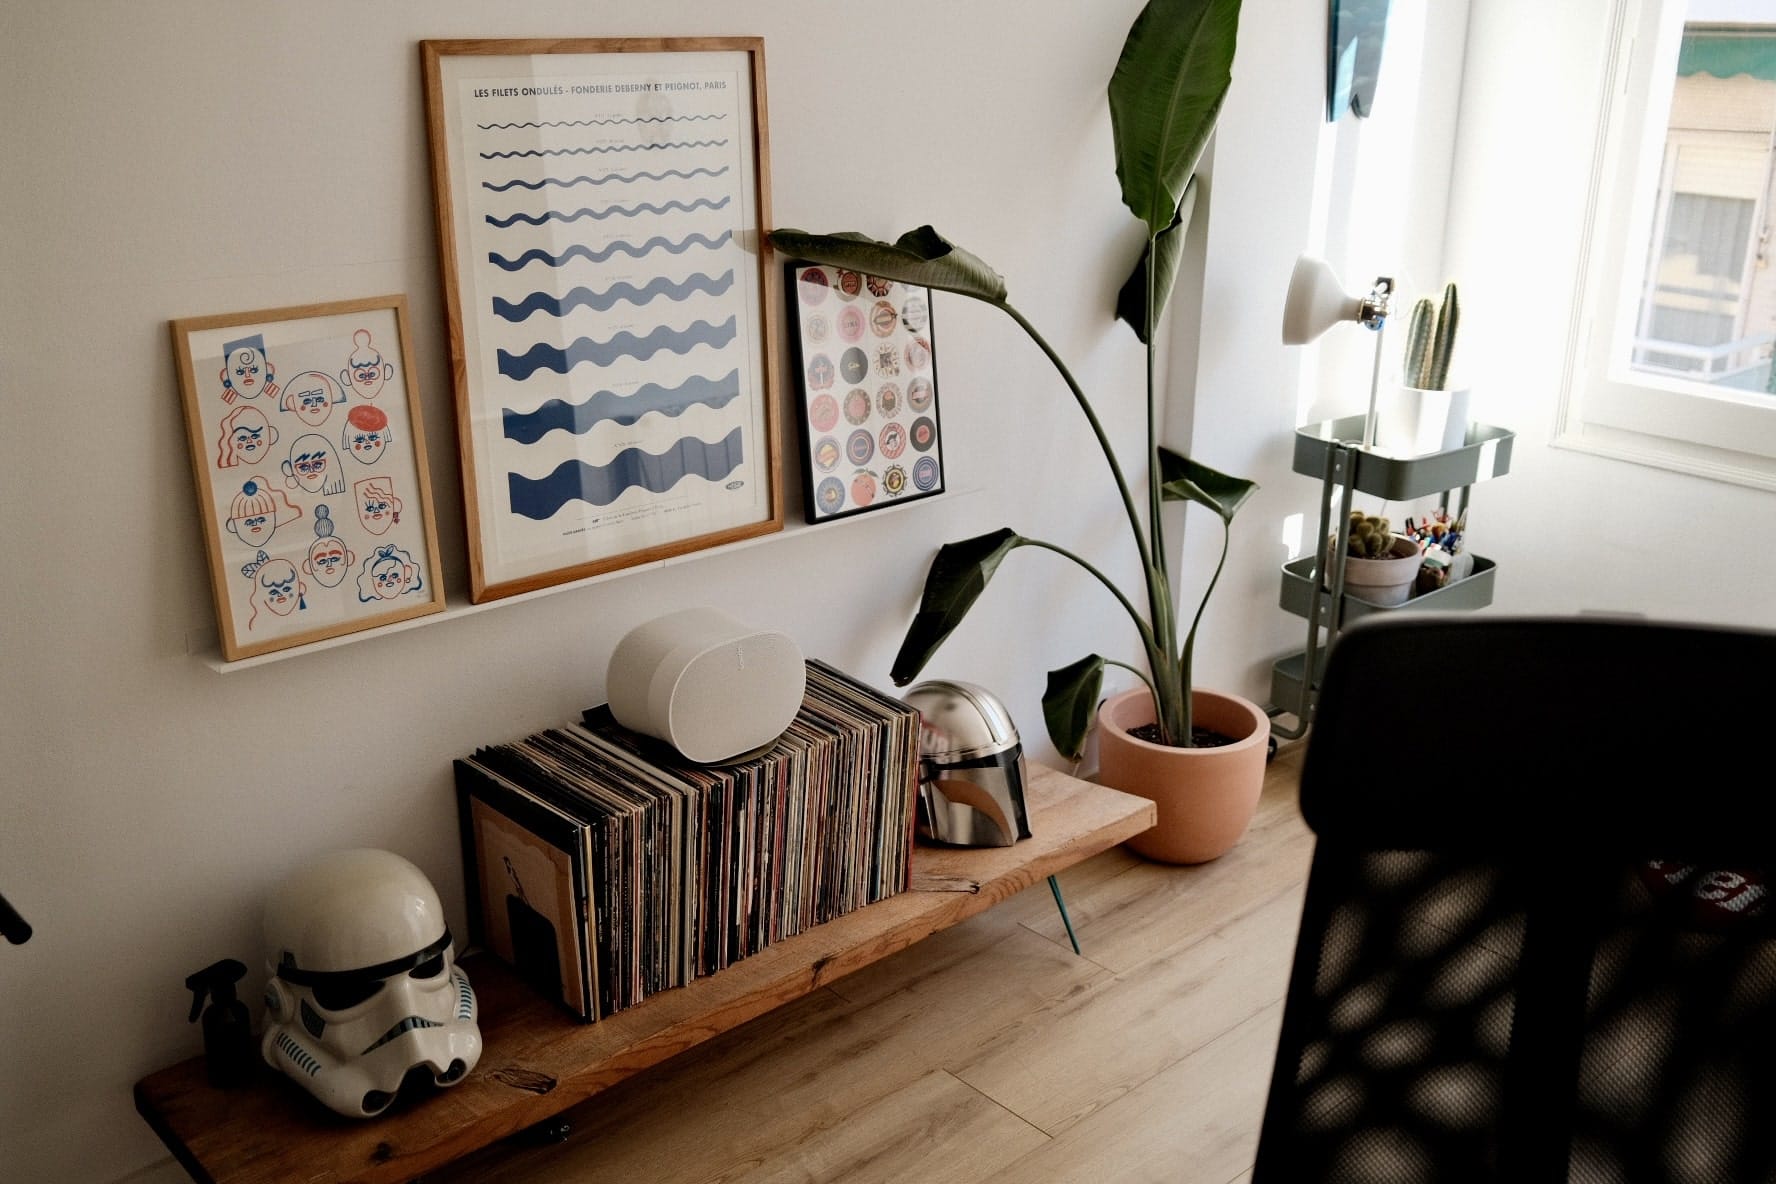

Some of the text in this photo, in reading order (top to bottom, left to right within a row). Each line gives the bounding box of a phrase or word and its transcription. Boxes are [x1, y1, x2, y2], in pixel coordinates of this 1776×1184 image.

[474, 89, 489, 98] LES
[492, 88, 519, 97] FILETS
[521, 85, 563, 96] ONDULÉS
[571, 84, 613, 94] FONDERIE
[615, 83, 651, 93] DEBERNY
[654, 83, 663, 92] ET
[704, 81, 727, 90] PARIS
